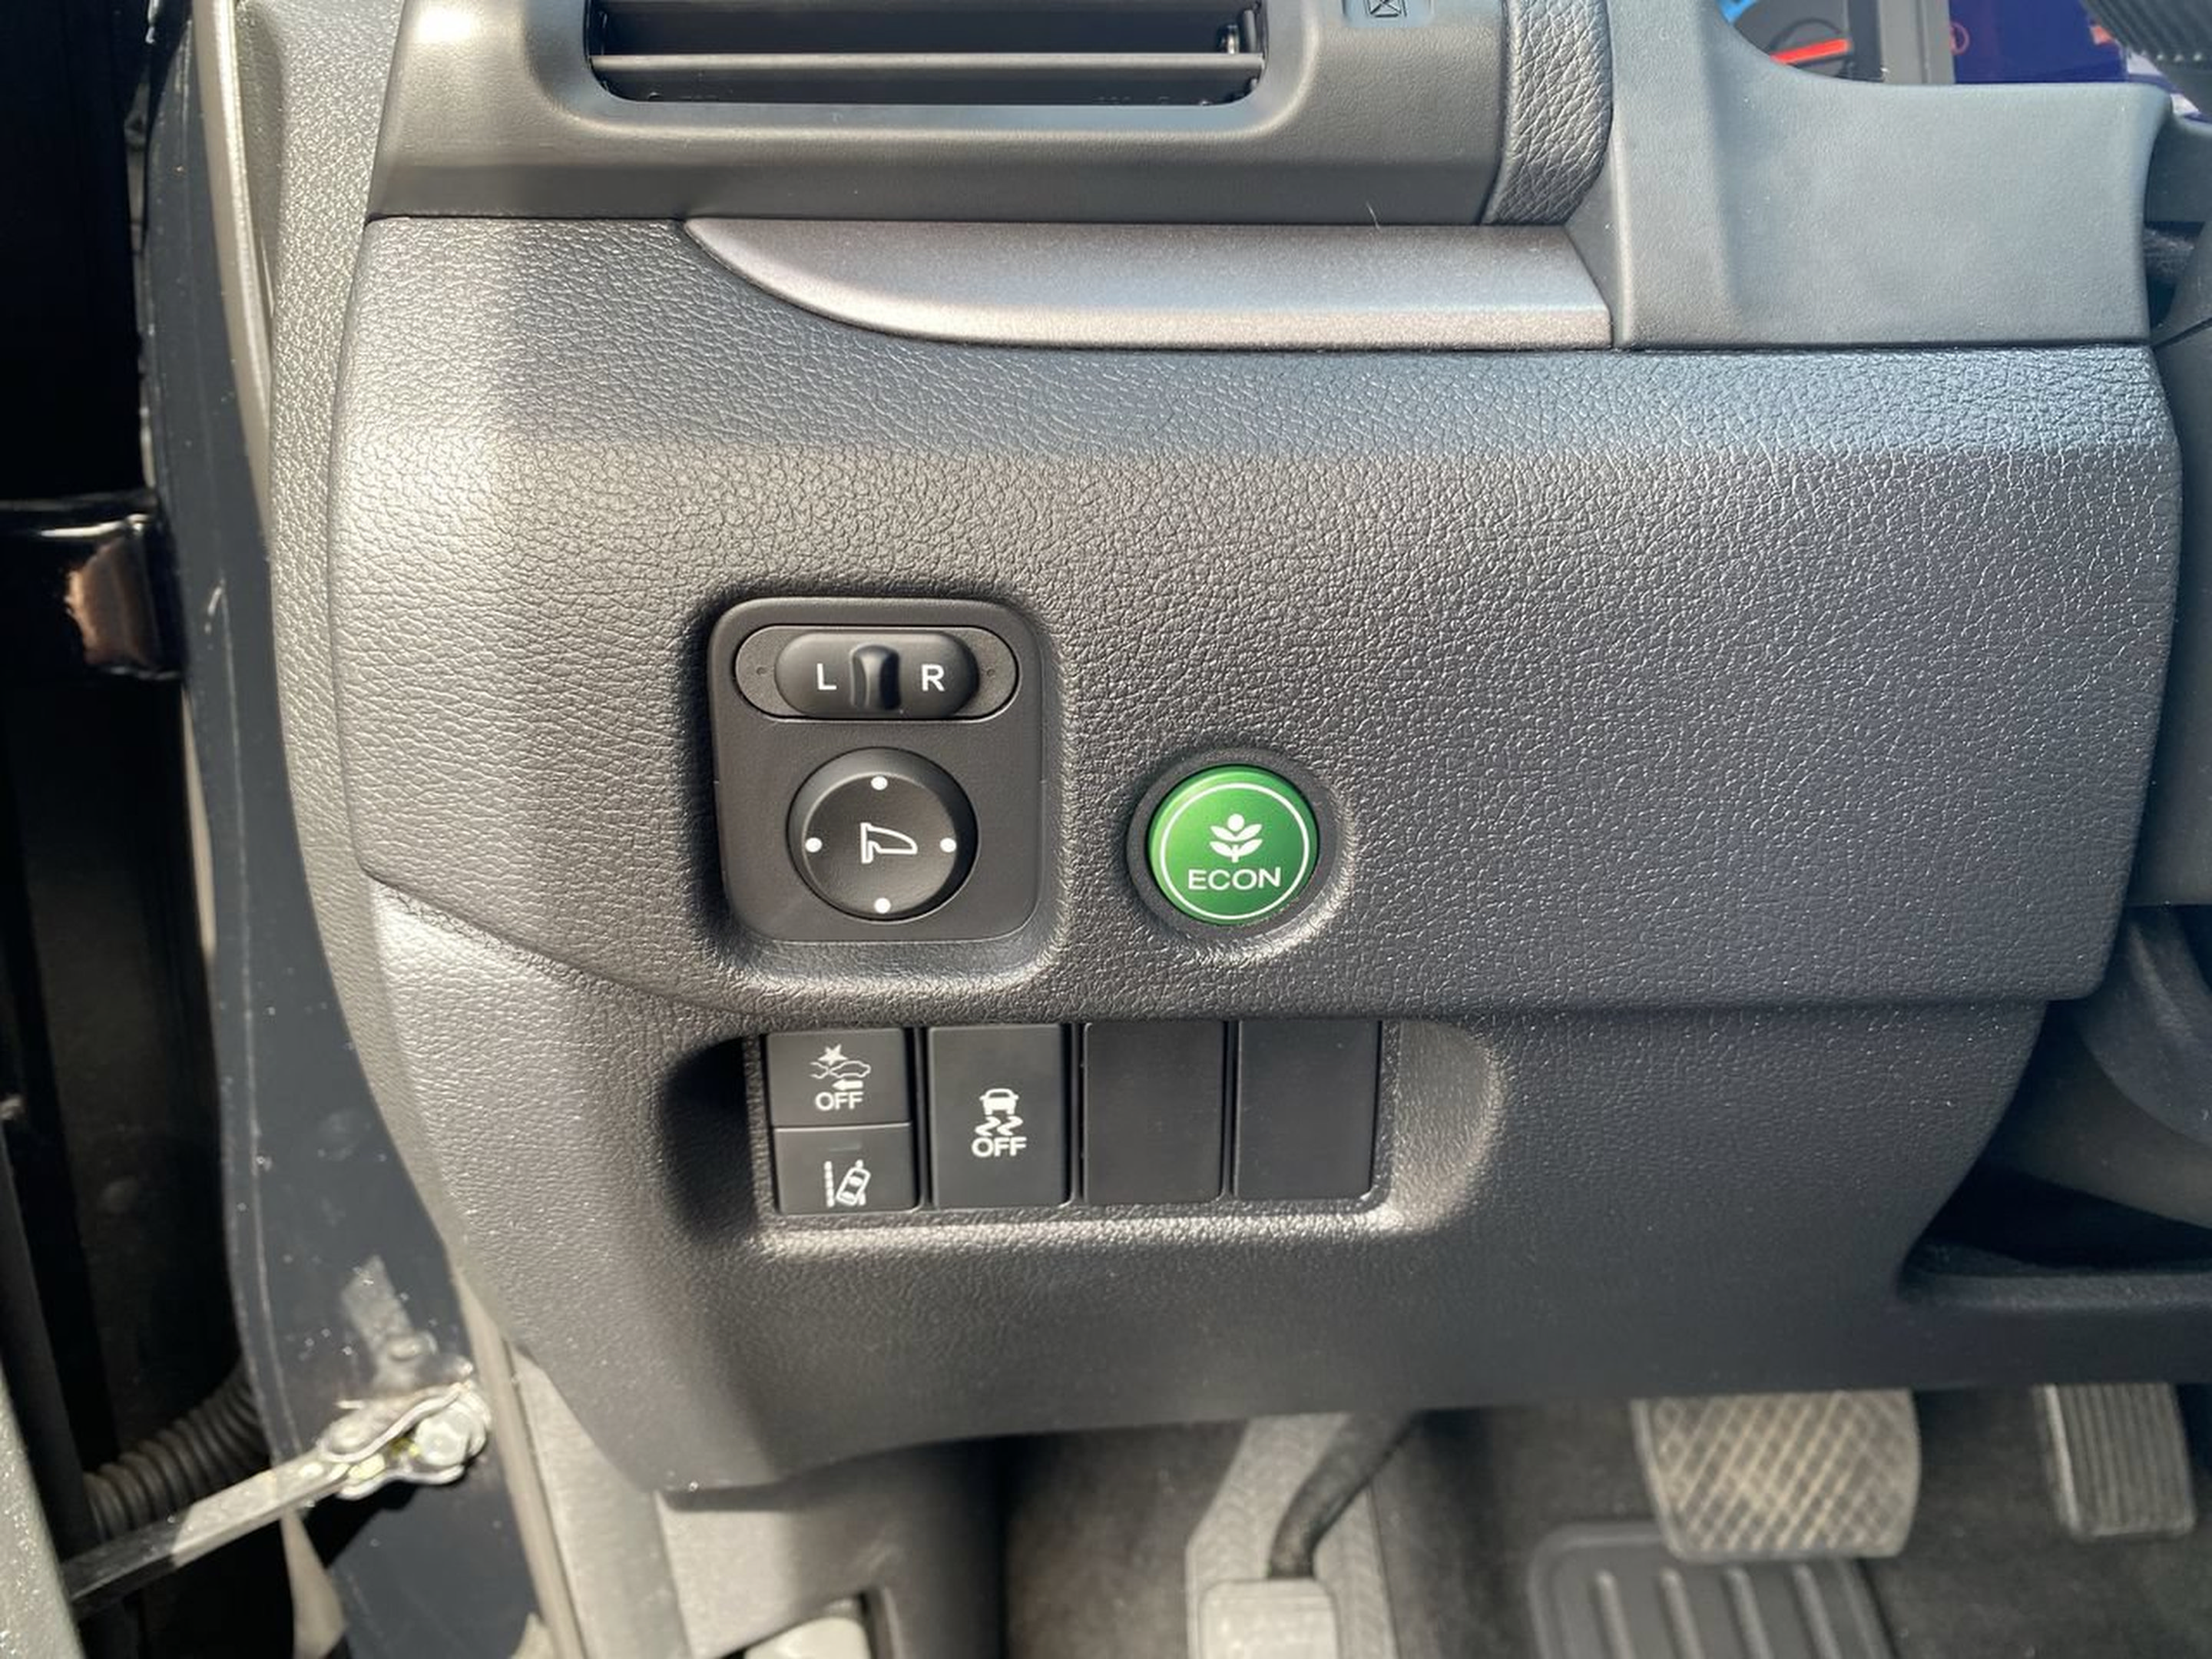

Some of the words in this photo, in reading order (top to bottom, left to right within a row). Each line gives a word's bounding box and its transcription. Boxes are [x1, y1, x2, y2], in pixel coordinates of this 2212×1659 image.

[816, 663, 837, 690] L
[922, 664, 945, 691] R
[1187, 867, 1281, 891] ECON
[815, 1091, 864, 1111] OFF
[971, 1137, 1028, 1157] OFF
